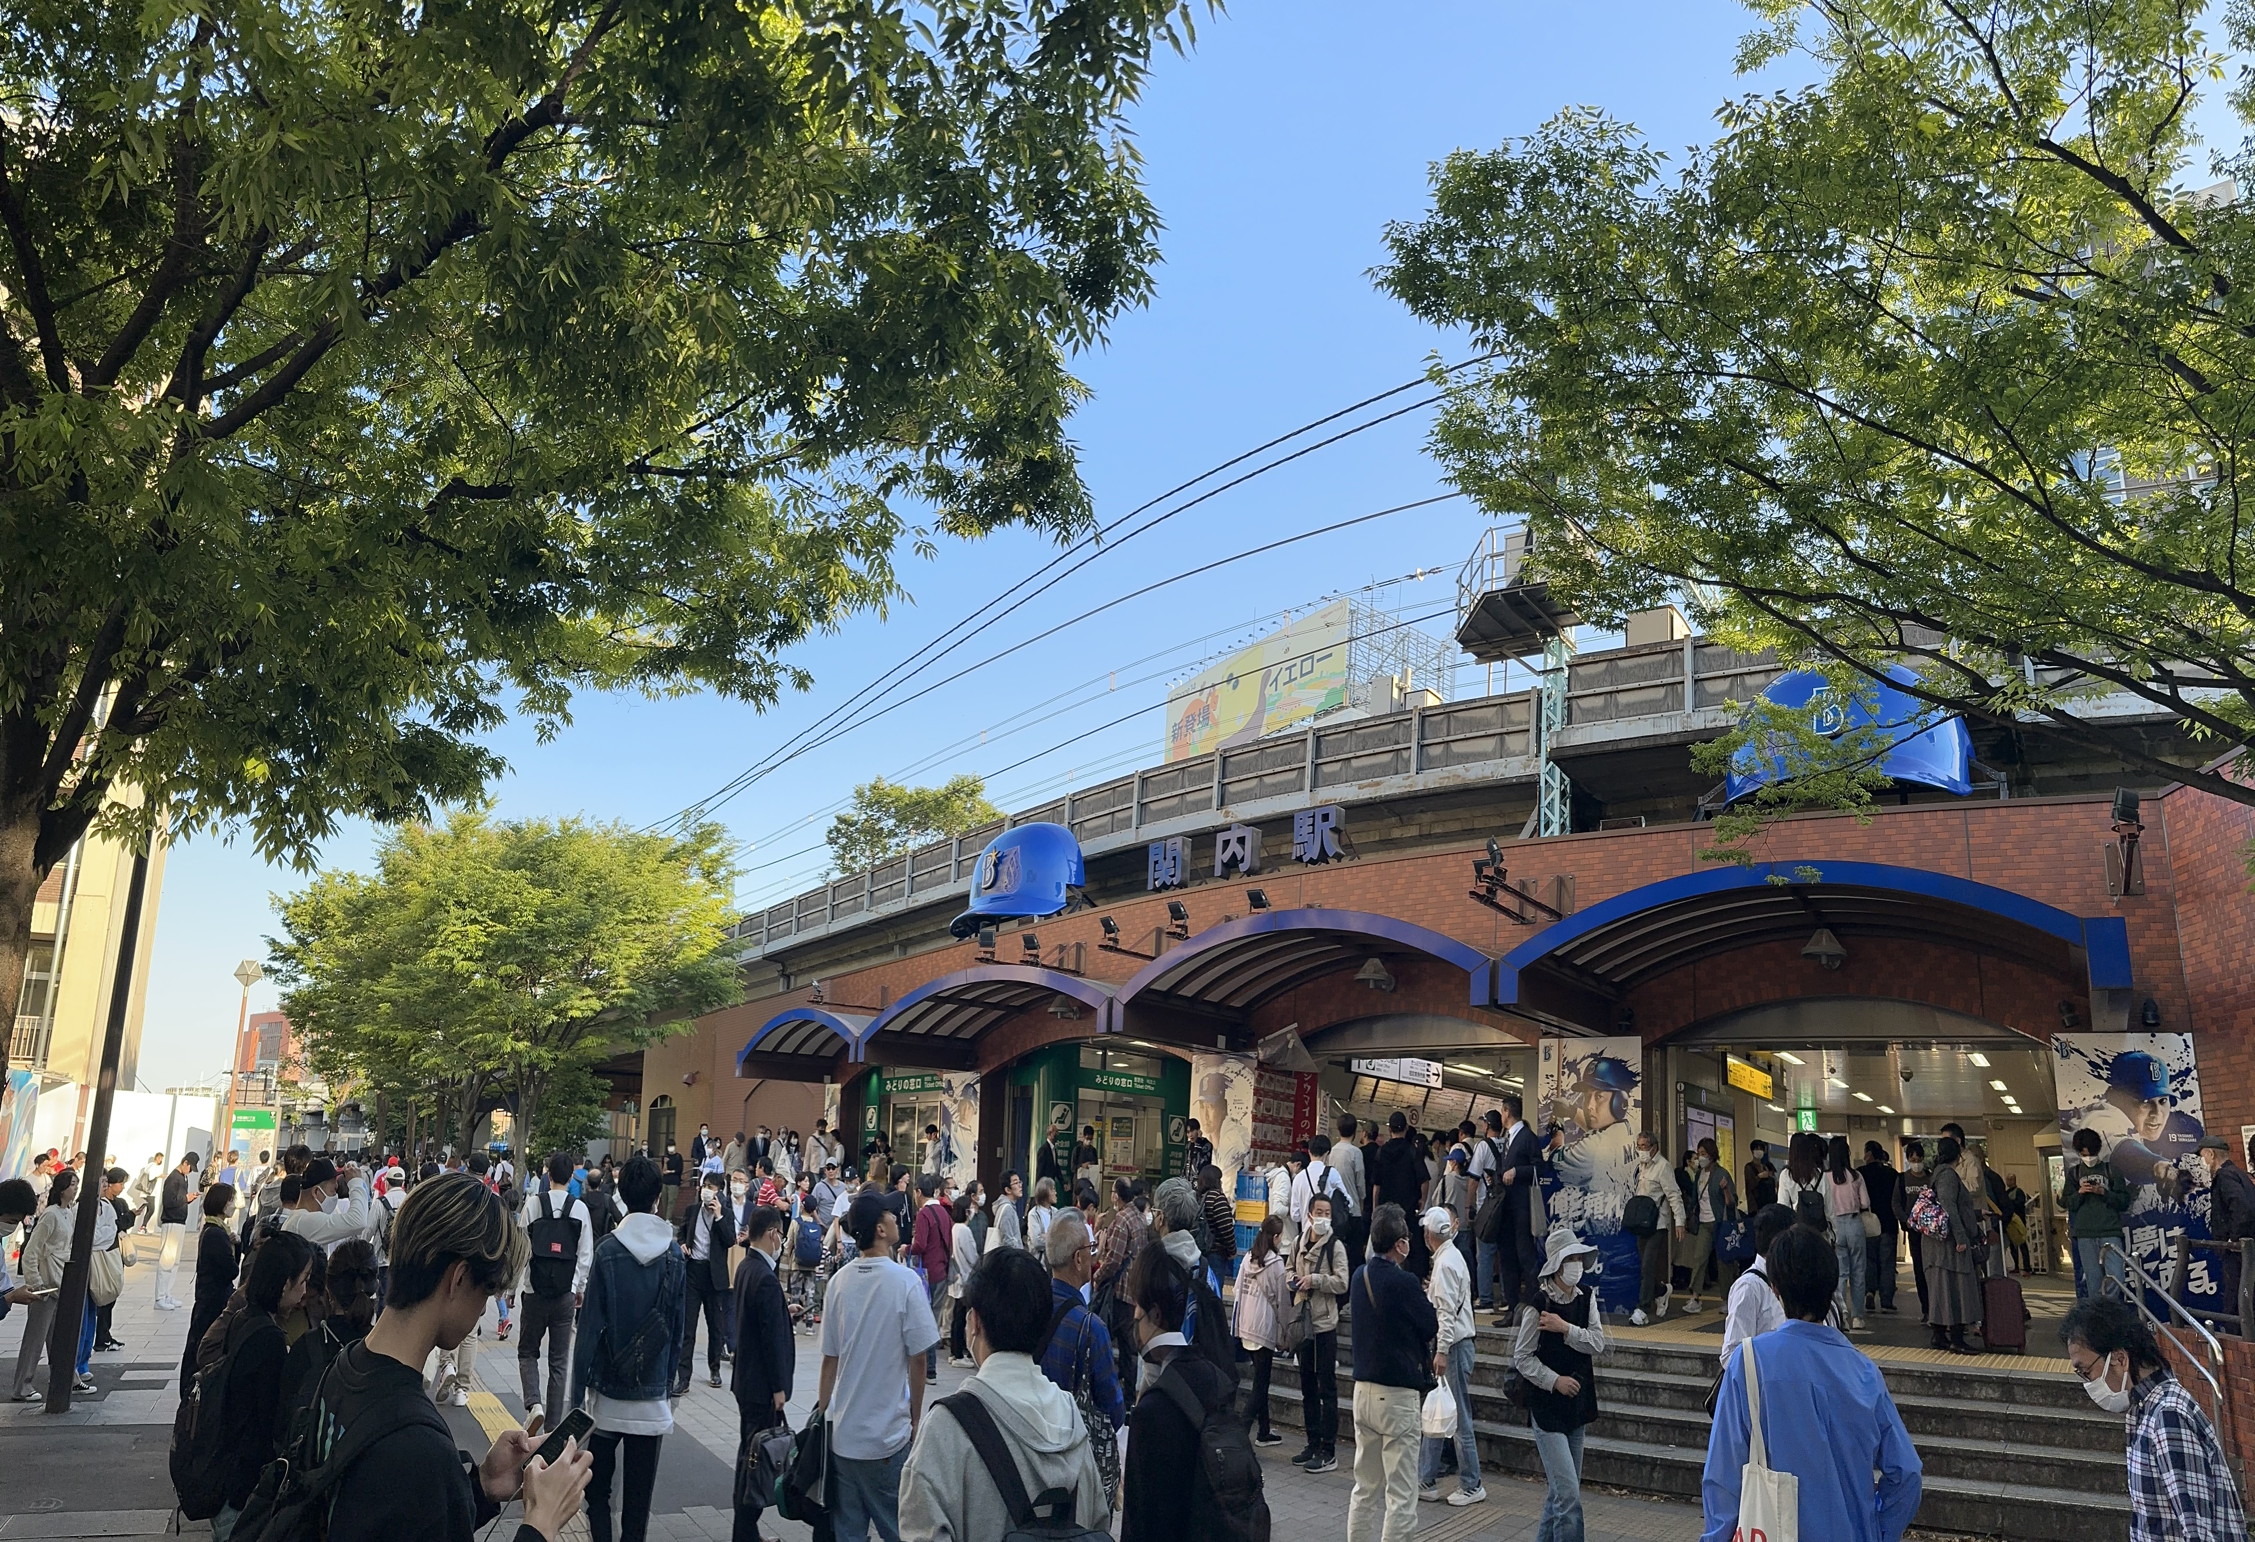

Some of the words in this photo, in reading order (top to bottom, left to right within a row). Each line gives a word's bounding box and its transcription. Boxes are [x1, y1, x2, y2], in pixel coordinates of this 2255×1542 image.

[1269, 652, 1333, 691] イエロー
[1171, 704, 1211, 745] 新登場
[1147, 805, 1344, 891] 関内駅
[885, 1078, 922, 1092] みどりの窓口
[1095, 1074, 1133, 1088] みどりの窓口
[2168, 1133, 2178, 1142] 19
